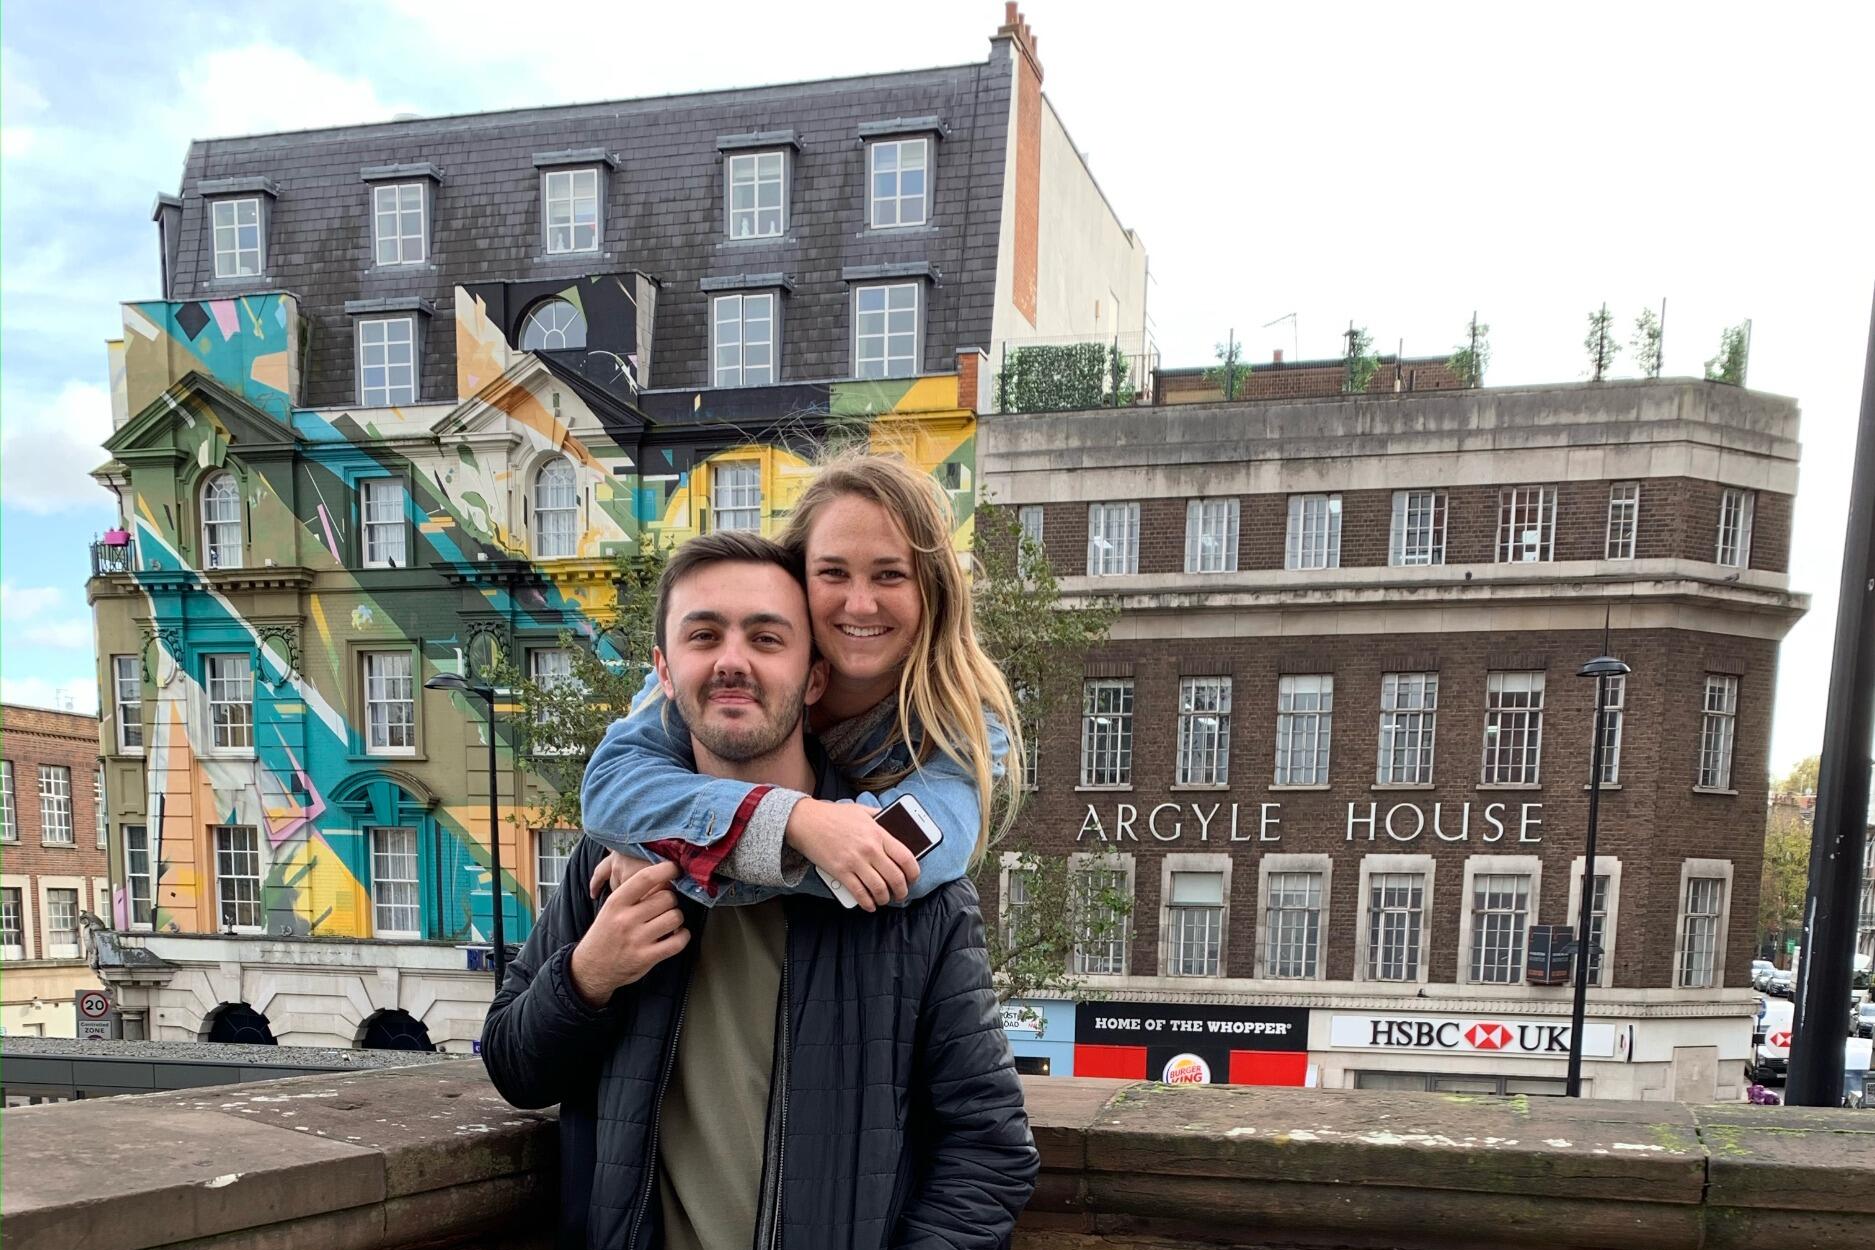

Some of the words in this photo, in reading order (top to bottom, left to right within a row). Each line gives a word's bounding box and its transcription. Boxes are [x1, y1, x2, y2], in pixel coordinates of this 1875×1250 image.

[1076, 803, 1281, 841] ARGYLE
[1346, 802, 1543, 842] HOUSE
[85, 1000, 104, 1011] 20
[1094, 1017, 1141, 1031] HOME
[1144, 1018, 1166, 1032] OF
[1169, 1019, 1203, 1033] THE
[1369, 1020, 1460, 1047] HSBC
[1517, 1025, 1571, 1052] UK
[1169, 1065, 1202, 1079] BURGER
